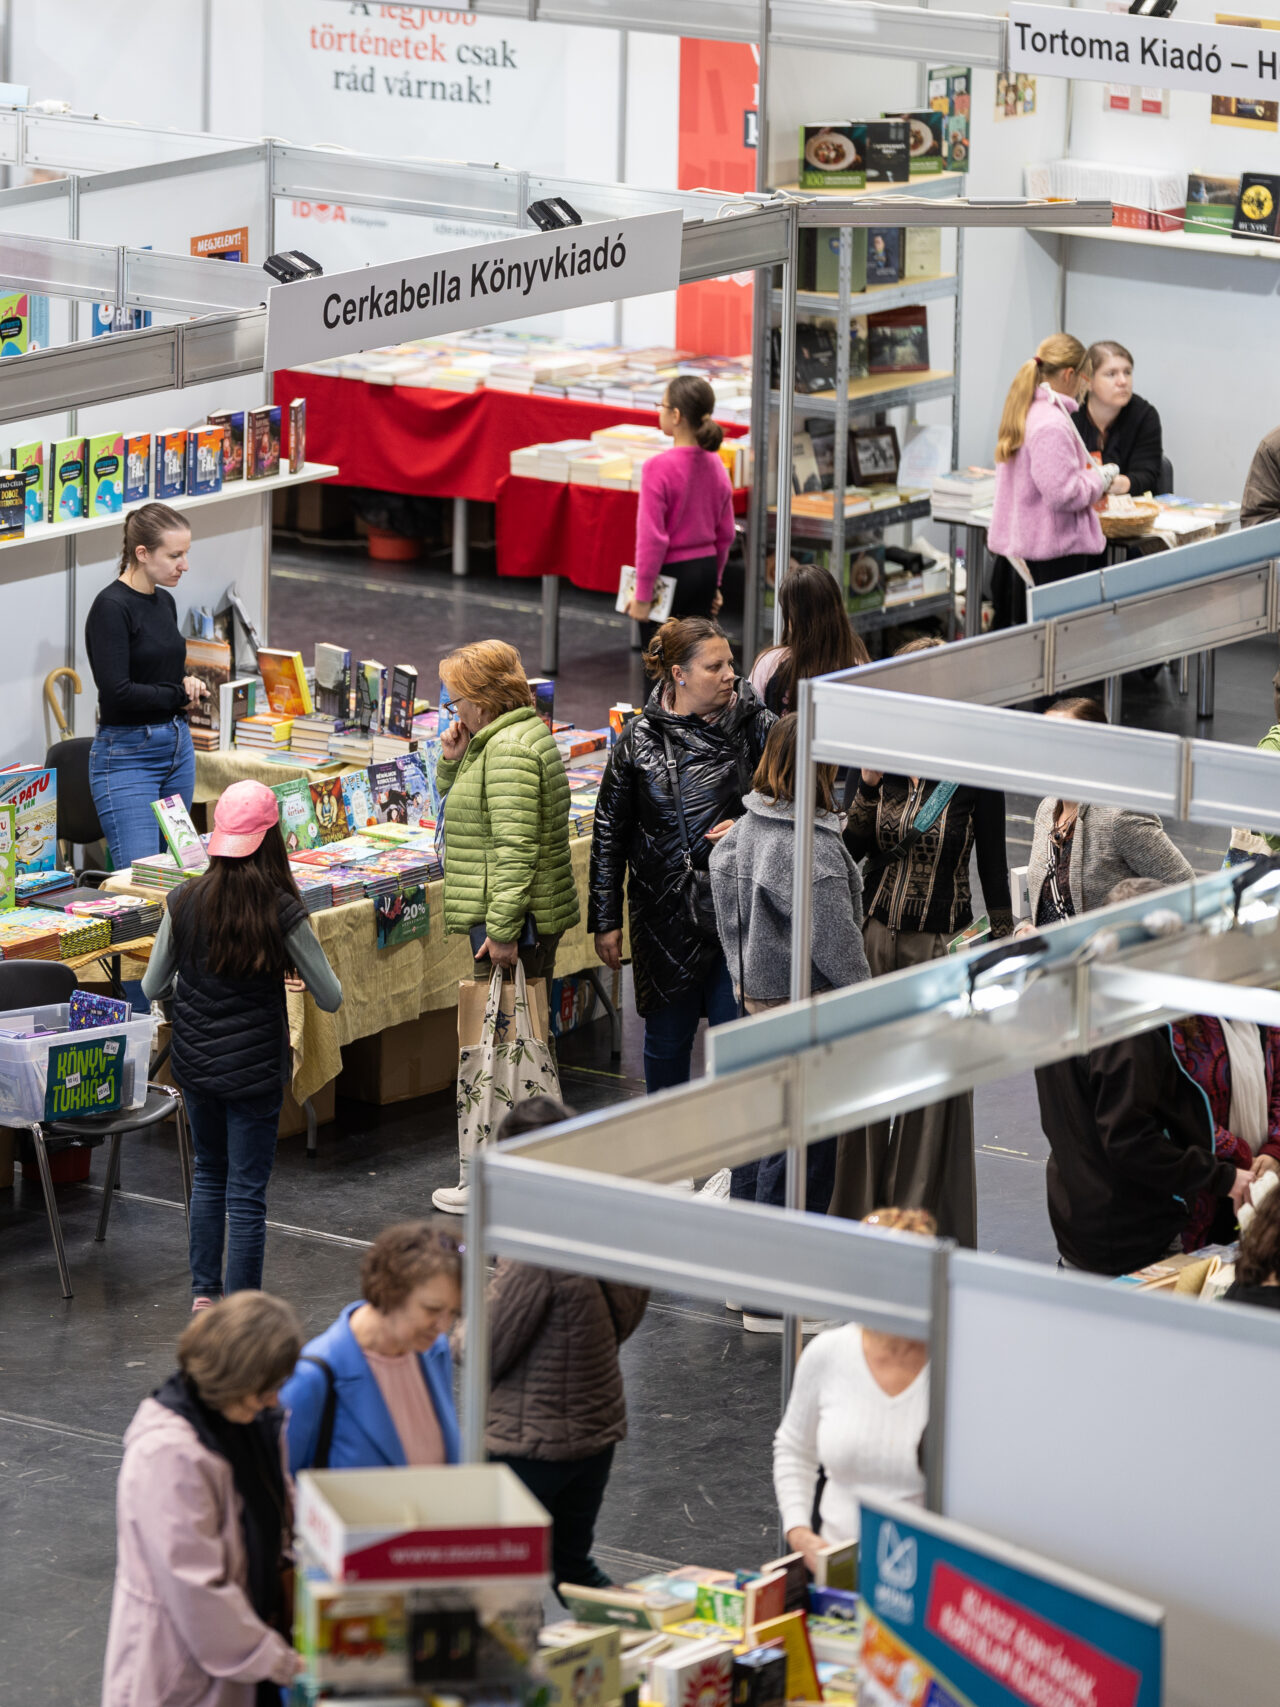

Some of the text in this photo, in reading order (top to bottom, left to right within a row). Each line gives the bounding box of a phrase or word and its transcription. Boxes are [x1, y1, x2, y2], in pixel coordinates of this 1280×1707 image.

[310, 24, 518, 69] történetek csak
[1014, 22, 1130, 63] Tortoma
[1140, 36, 1222, 73] Kiadó
[333, 64, 492, 105] rád várnak!
[197, 231, 242, 253] MEGJELENT!
[322, 233, 627, 330] Cerkabella Könyvkiadó
[19, 772, 51, 805] PATU
[403, 902, 426, 921] 20%
[57, 1046, 116, 1080] KÖNYV-
